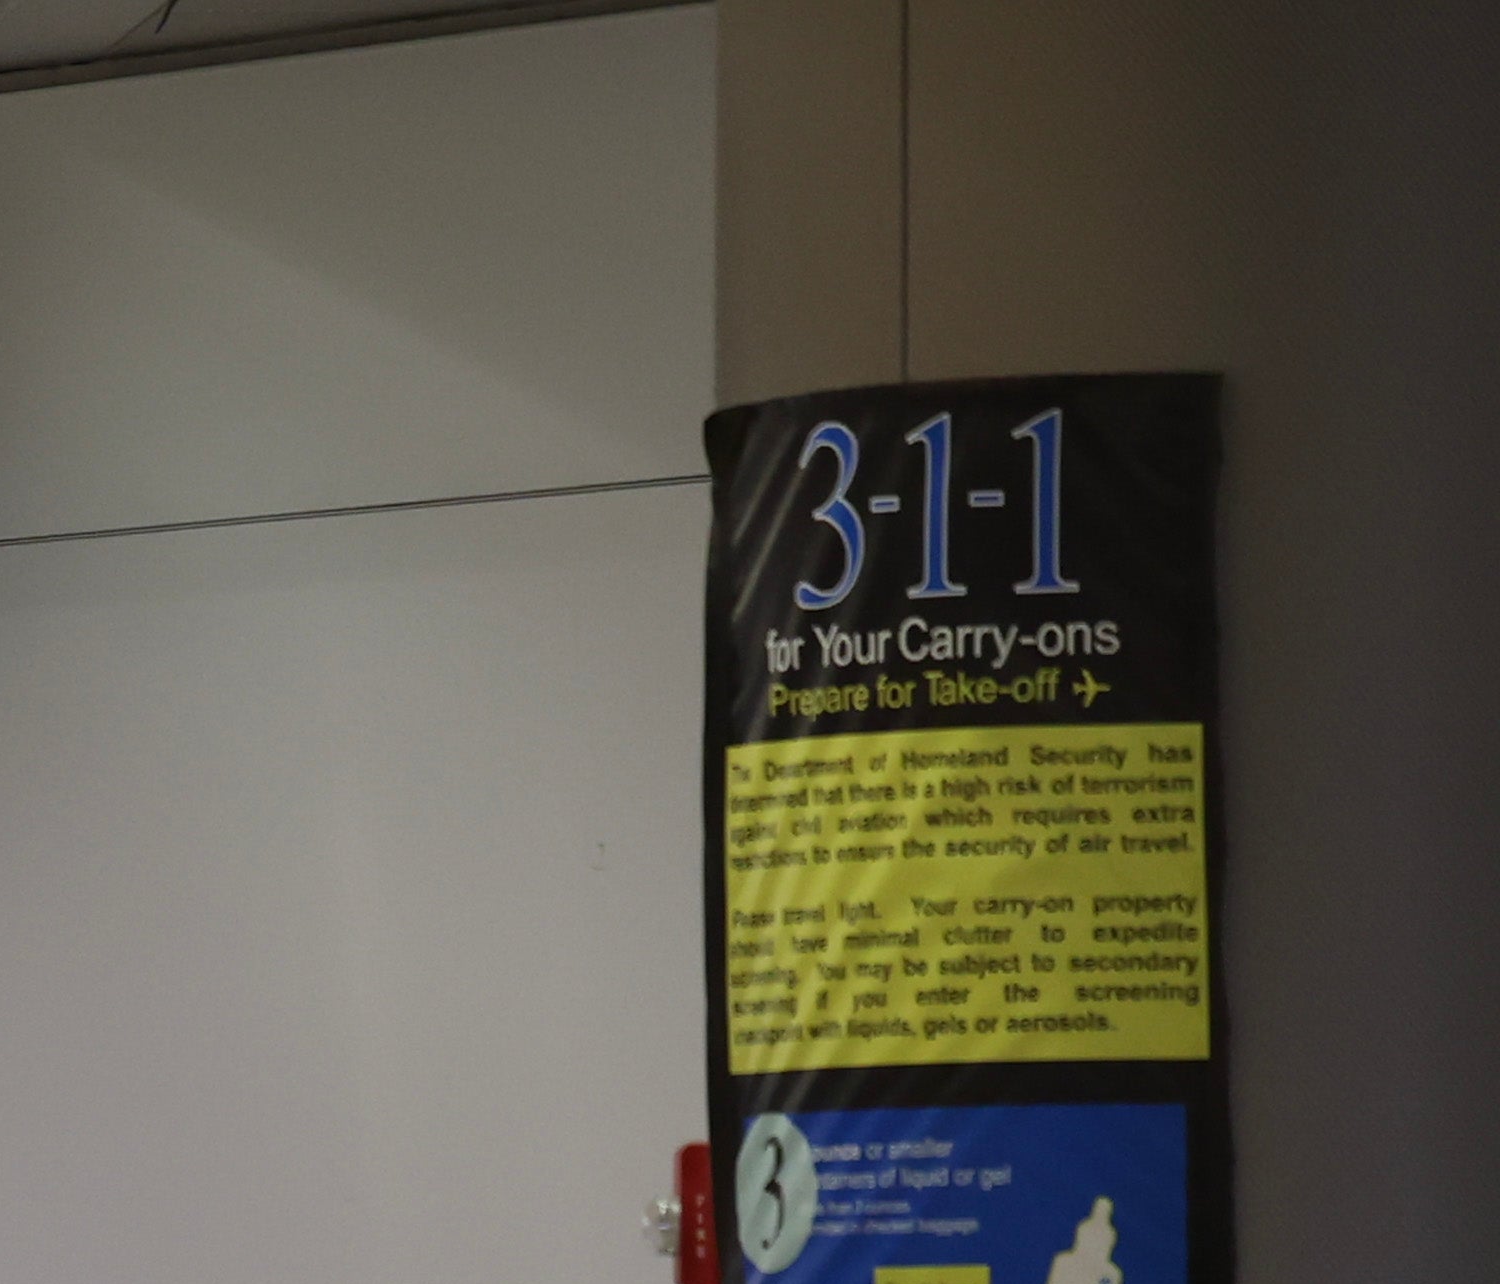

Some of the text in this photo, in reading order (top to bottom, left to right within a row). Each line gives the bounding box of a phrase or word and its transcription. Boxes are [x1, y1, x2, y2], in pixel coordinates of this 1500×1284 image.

[793, 407, 1080, 612] 3-1-1
[765, 615, 1121, 673] for Your Carry-ons
[769, 667, 1062, 722] Prepare for Take-off
[1147, 743, 1194, 764] has
[1131, 806, 1196, 825] extra
[1092, 896, 1197, 917] property
[1040, 924, 1067, 944] to
